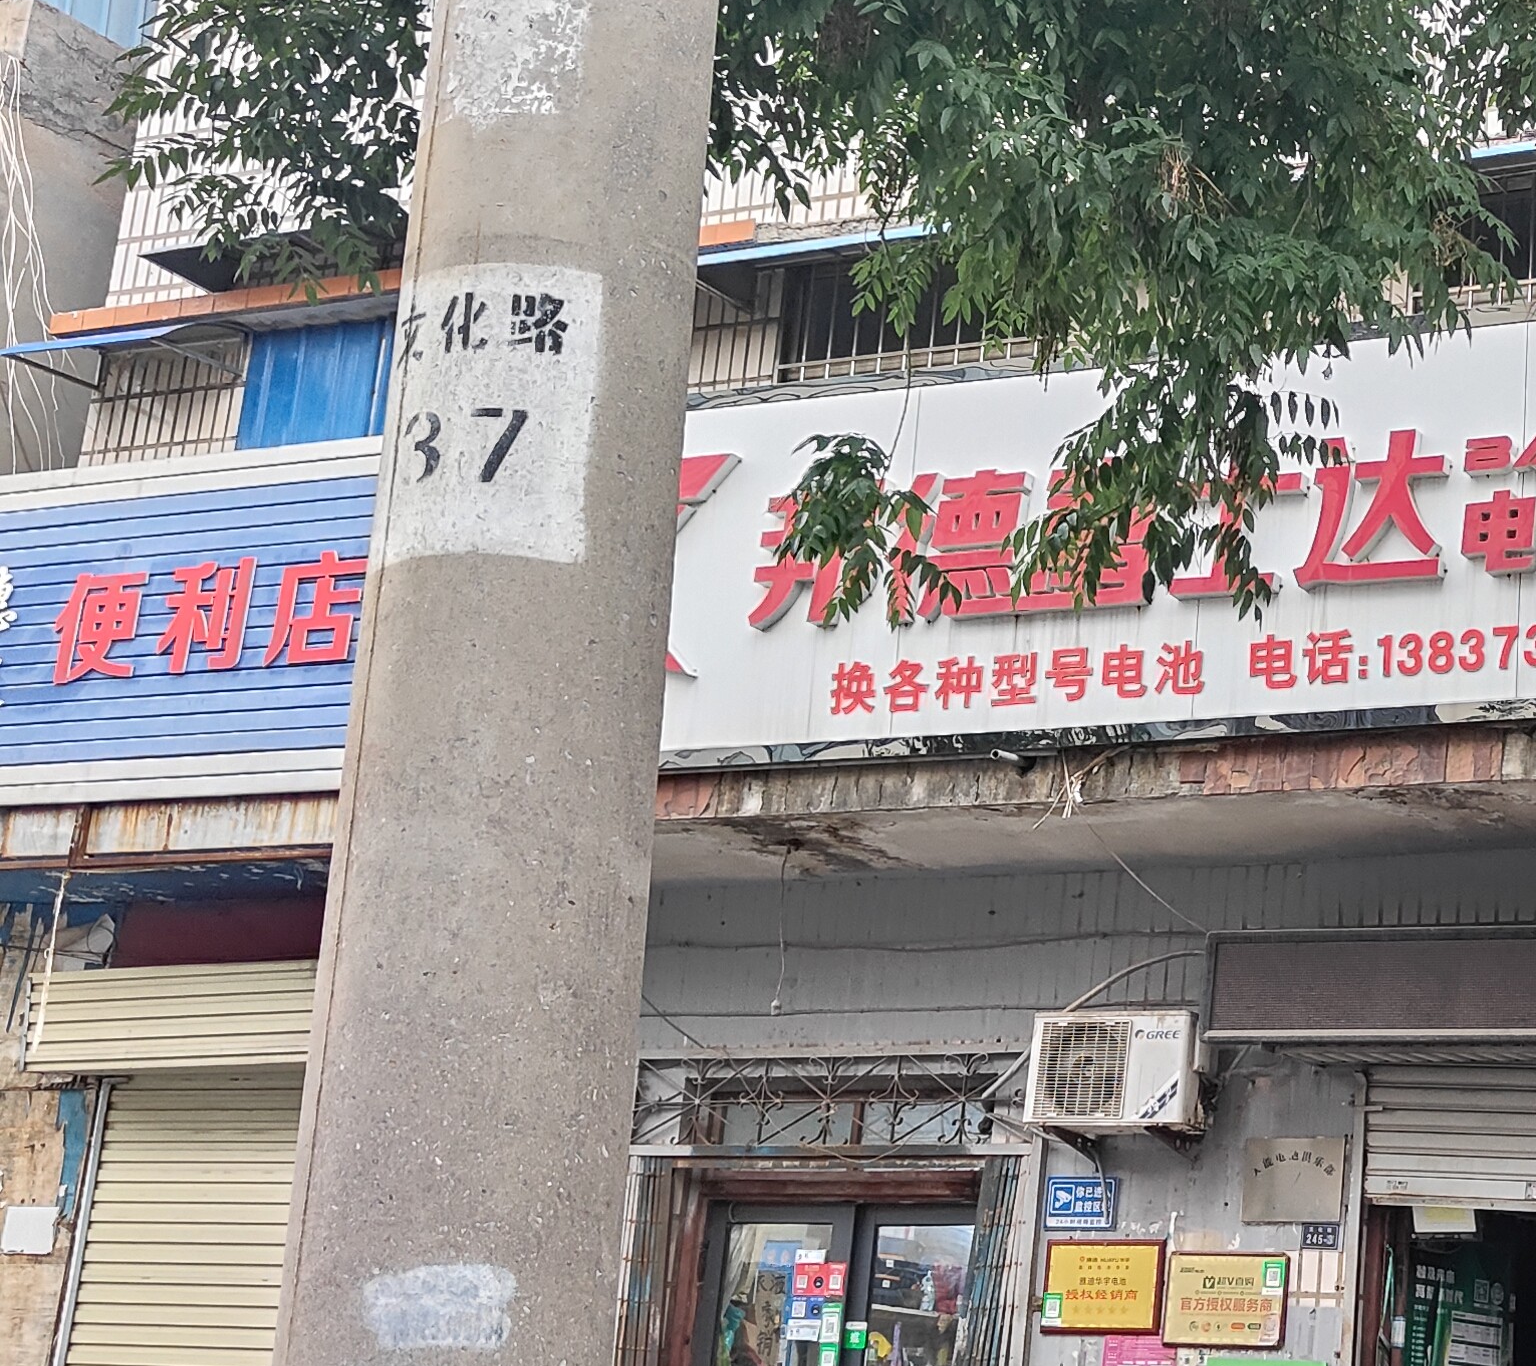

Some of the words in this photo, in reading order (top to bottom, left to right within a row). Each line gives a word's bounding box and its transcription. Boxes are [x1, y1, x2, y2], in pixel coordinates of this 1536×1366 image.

[405, 406, 529, 484] 37
[52, 549, 368, 686] 便利店
[830, 640, 1206, 716] 换各种型号电池
[1146, 1030, 1181, 1040] GREE
[1076, 1186, 1111, 1198] 你已进
[1074, 1201, 1111, 1213] 监控区
[1305, 1234, 1335, 1245] 245-3
[1065, 1288, 1139, 1301] 授权经销商
[1180, 1297, 1273, 1313] 官方授权服务商
